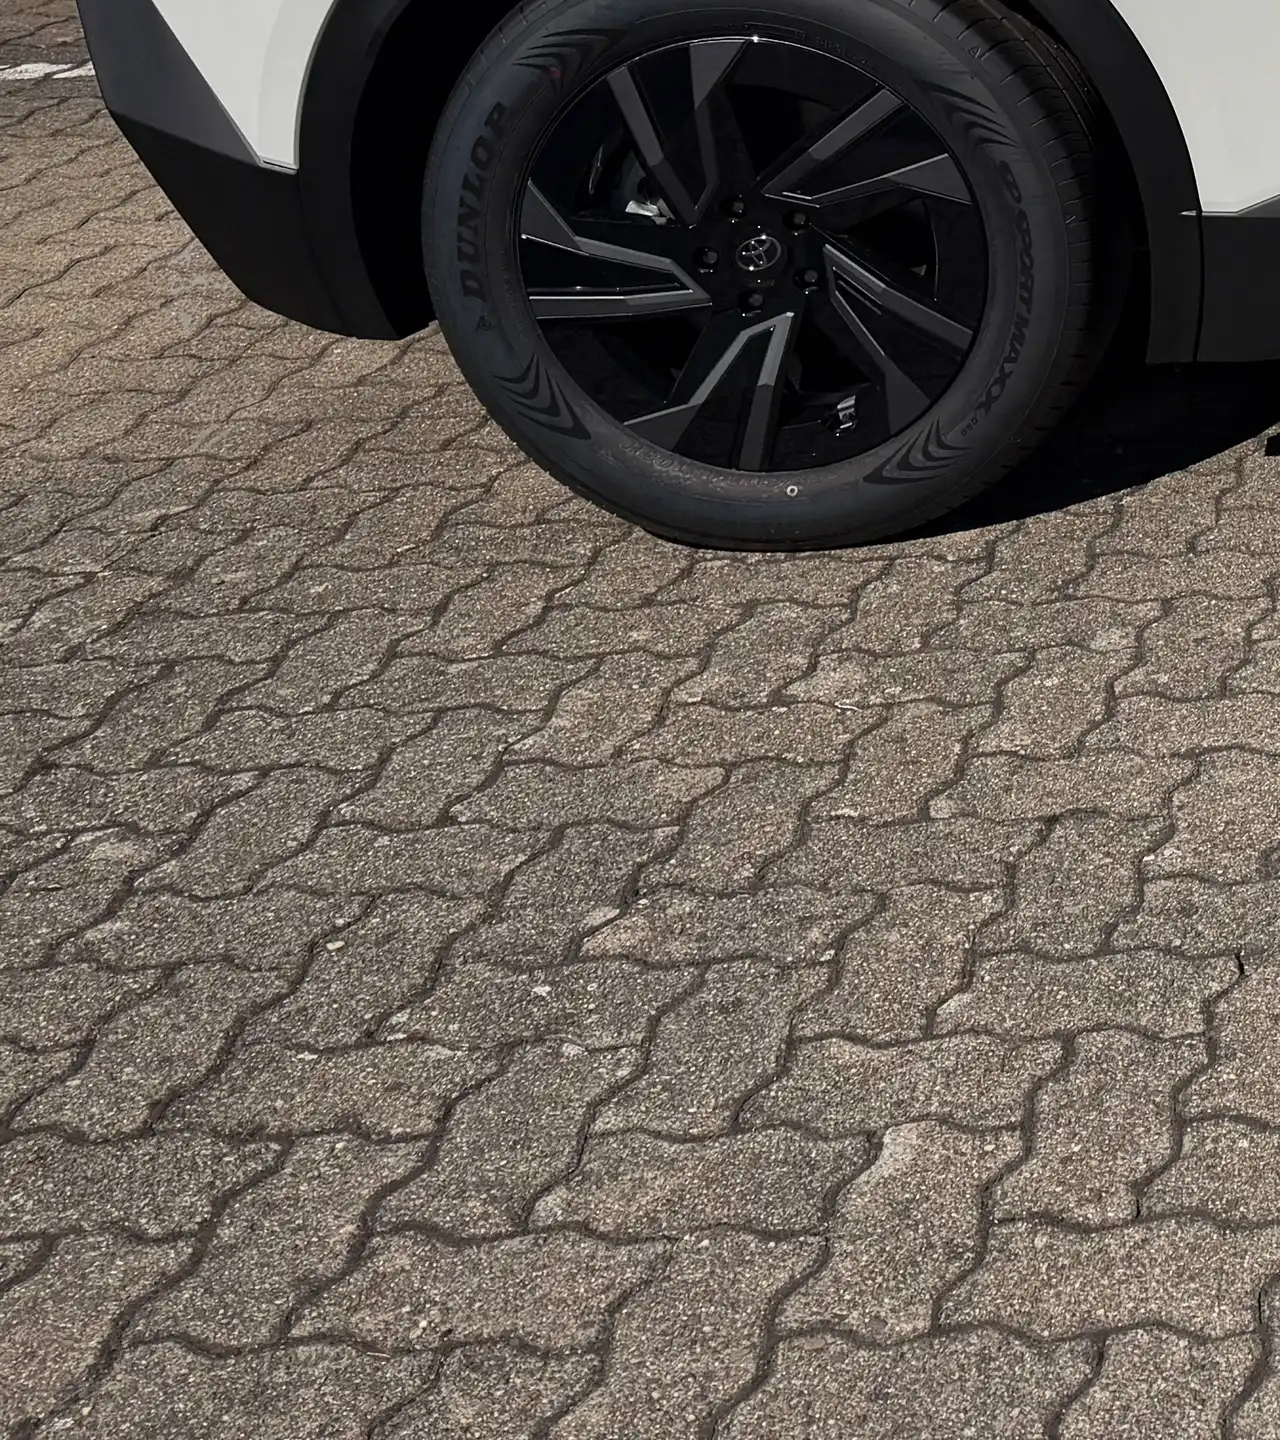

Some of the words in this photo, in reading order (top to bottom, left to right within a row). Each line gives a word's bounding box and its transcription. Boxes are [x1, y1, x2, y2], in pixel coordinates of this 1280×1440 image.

[457, 101, 506, 304] DUNLOP
[1015, 208, 1034, 314] SPORT
[974, 312, 1030, 416] MAXX
